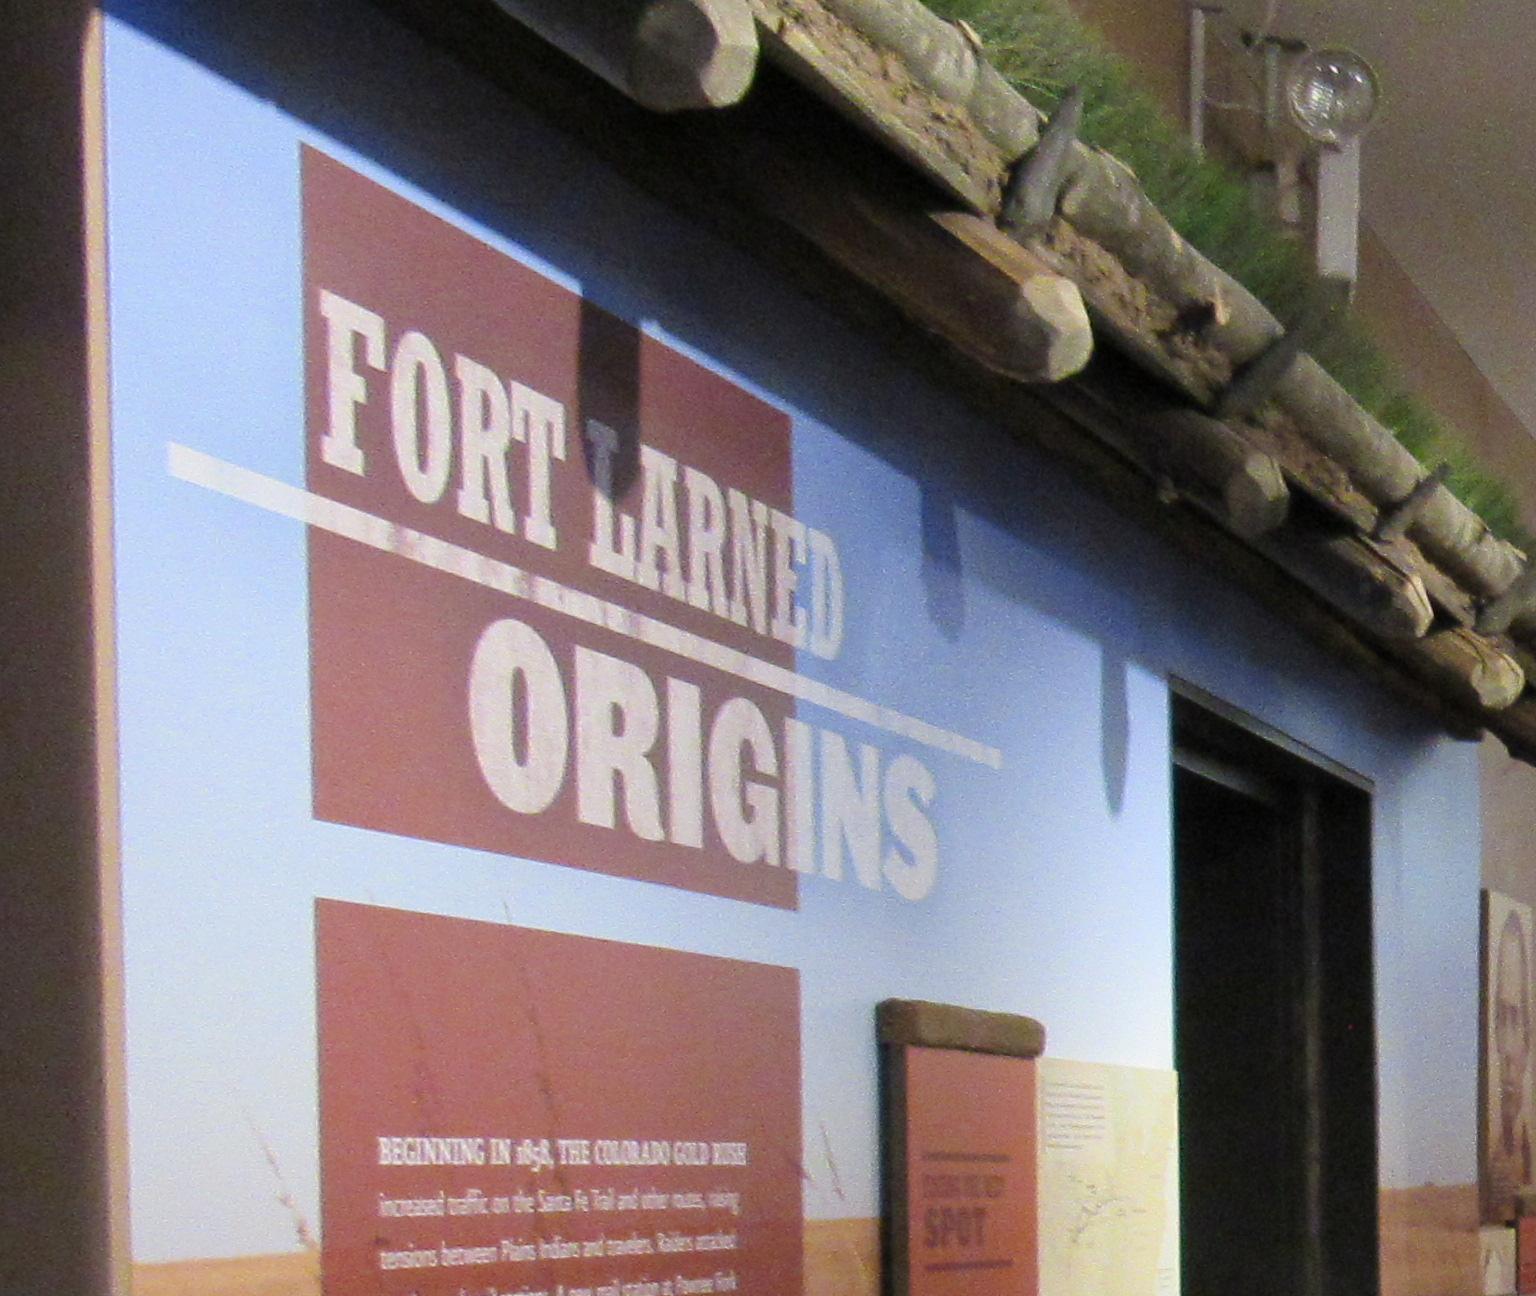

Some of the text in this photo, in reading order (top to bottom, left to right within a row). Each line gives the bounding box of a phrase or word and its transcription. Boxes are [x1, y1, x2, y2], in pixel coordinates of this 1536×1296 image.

[319, 287, 844, 662] FORT LARNED
[468, 617, 939, 901] ORIGINS
[378, 1136, 486, 1166] BEGINNING
[490, 1138, 511, 1166] IN
[557, 1138, 591, 1166] THE
[594, 1139, 672, 1166] COLORADO
